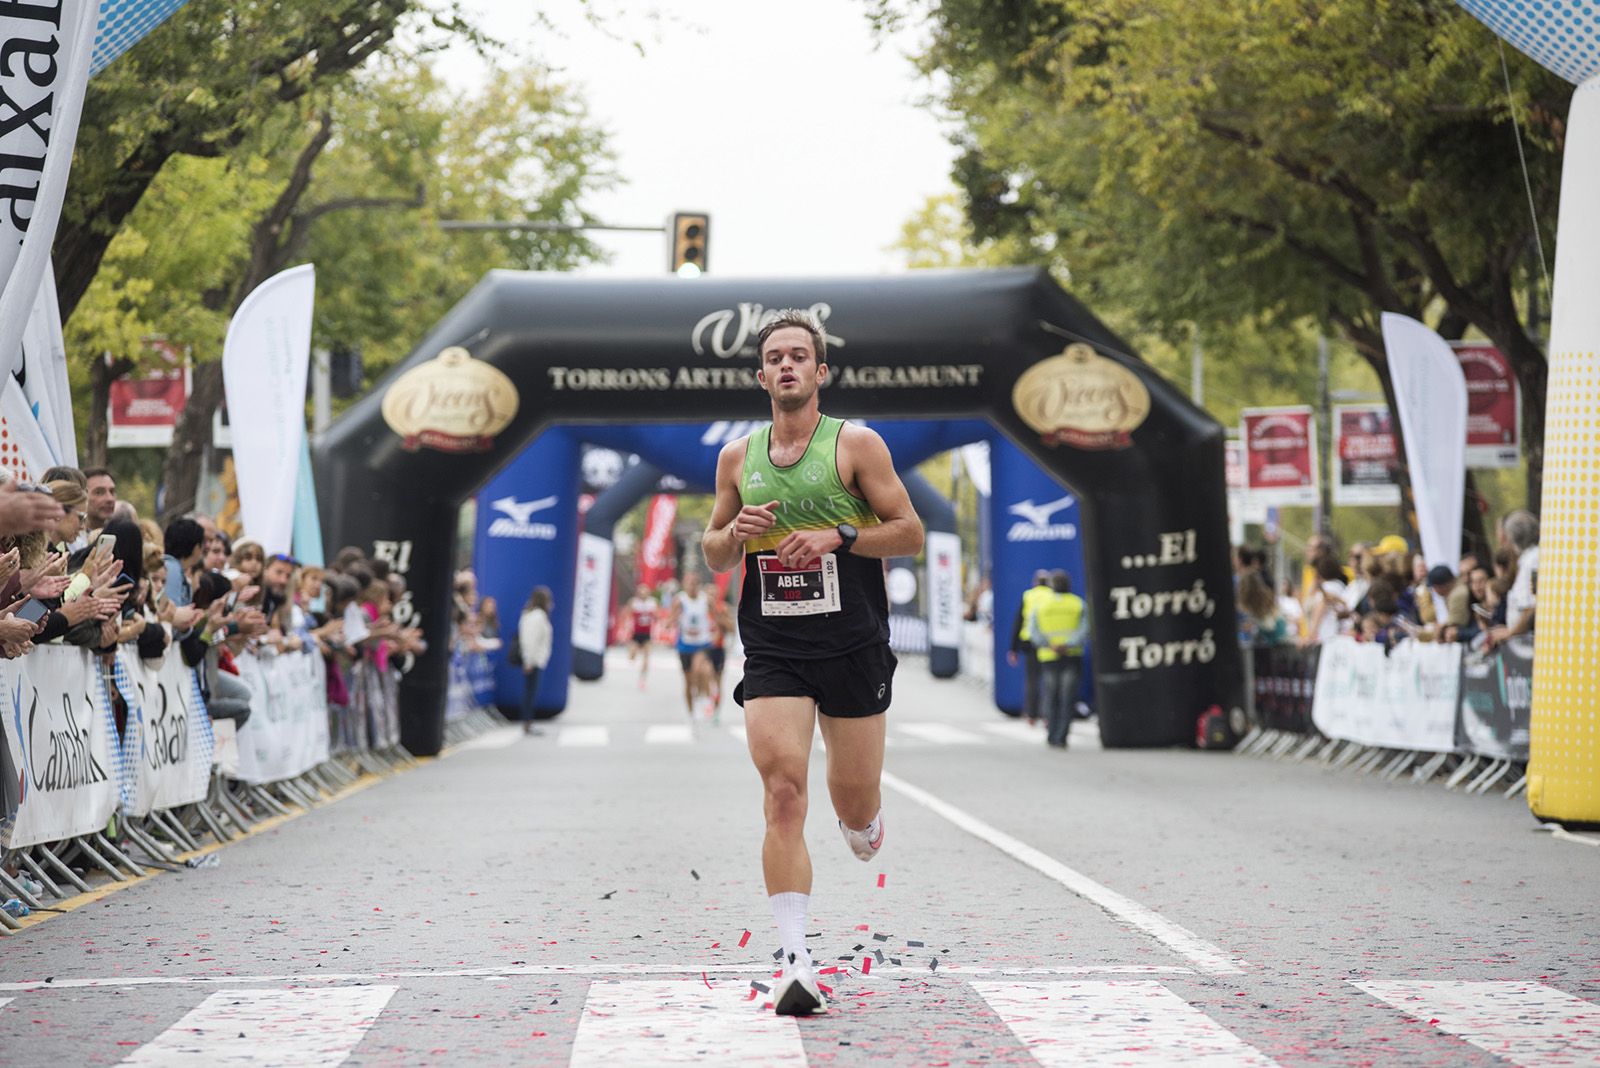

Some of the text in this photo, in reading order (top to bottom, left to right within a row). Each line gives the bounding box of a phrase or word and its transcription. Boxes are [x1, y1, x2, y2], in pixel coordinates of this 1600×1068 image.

[548, 366, 671, 390] TORRONS
[673, 366, 759, 390] ARTES
[826, 560, 834, 575] 102
[777, 575, 808, 588] ABEL
[784, 590, 802, 600] 102
[1110, 580, 1216, 620] Torró,
[1119, 630, 1216, 670] Torró
